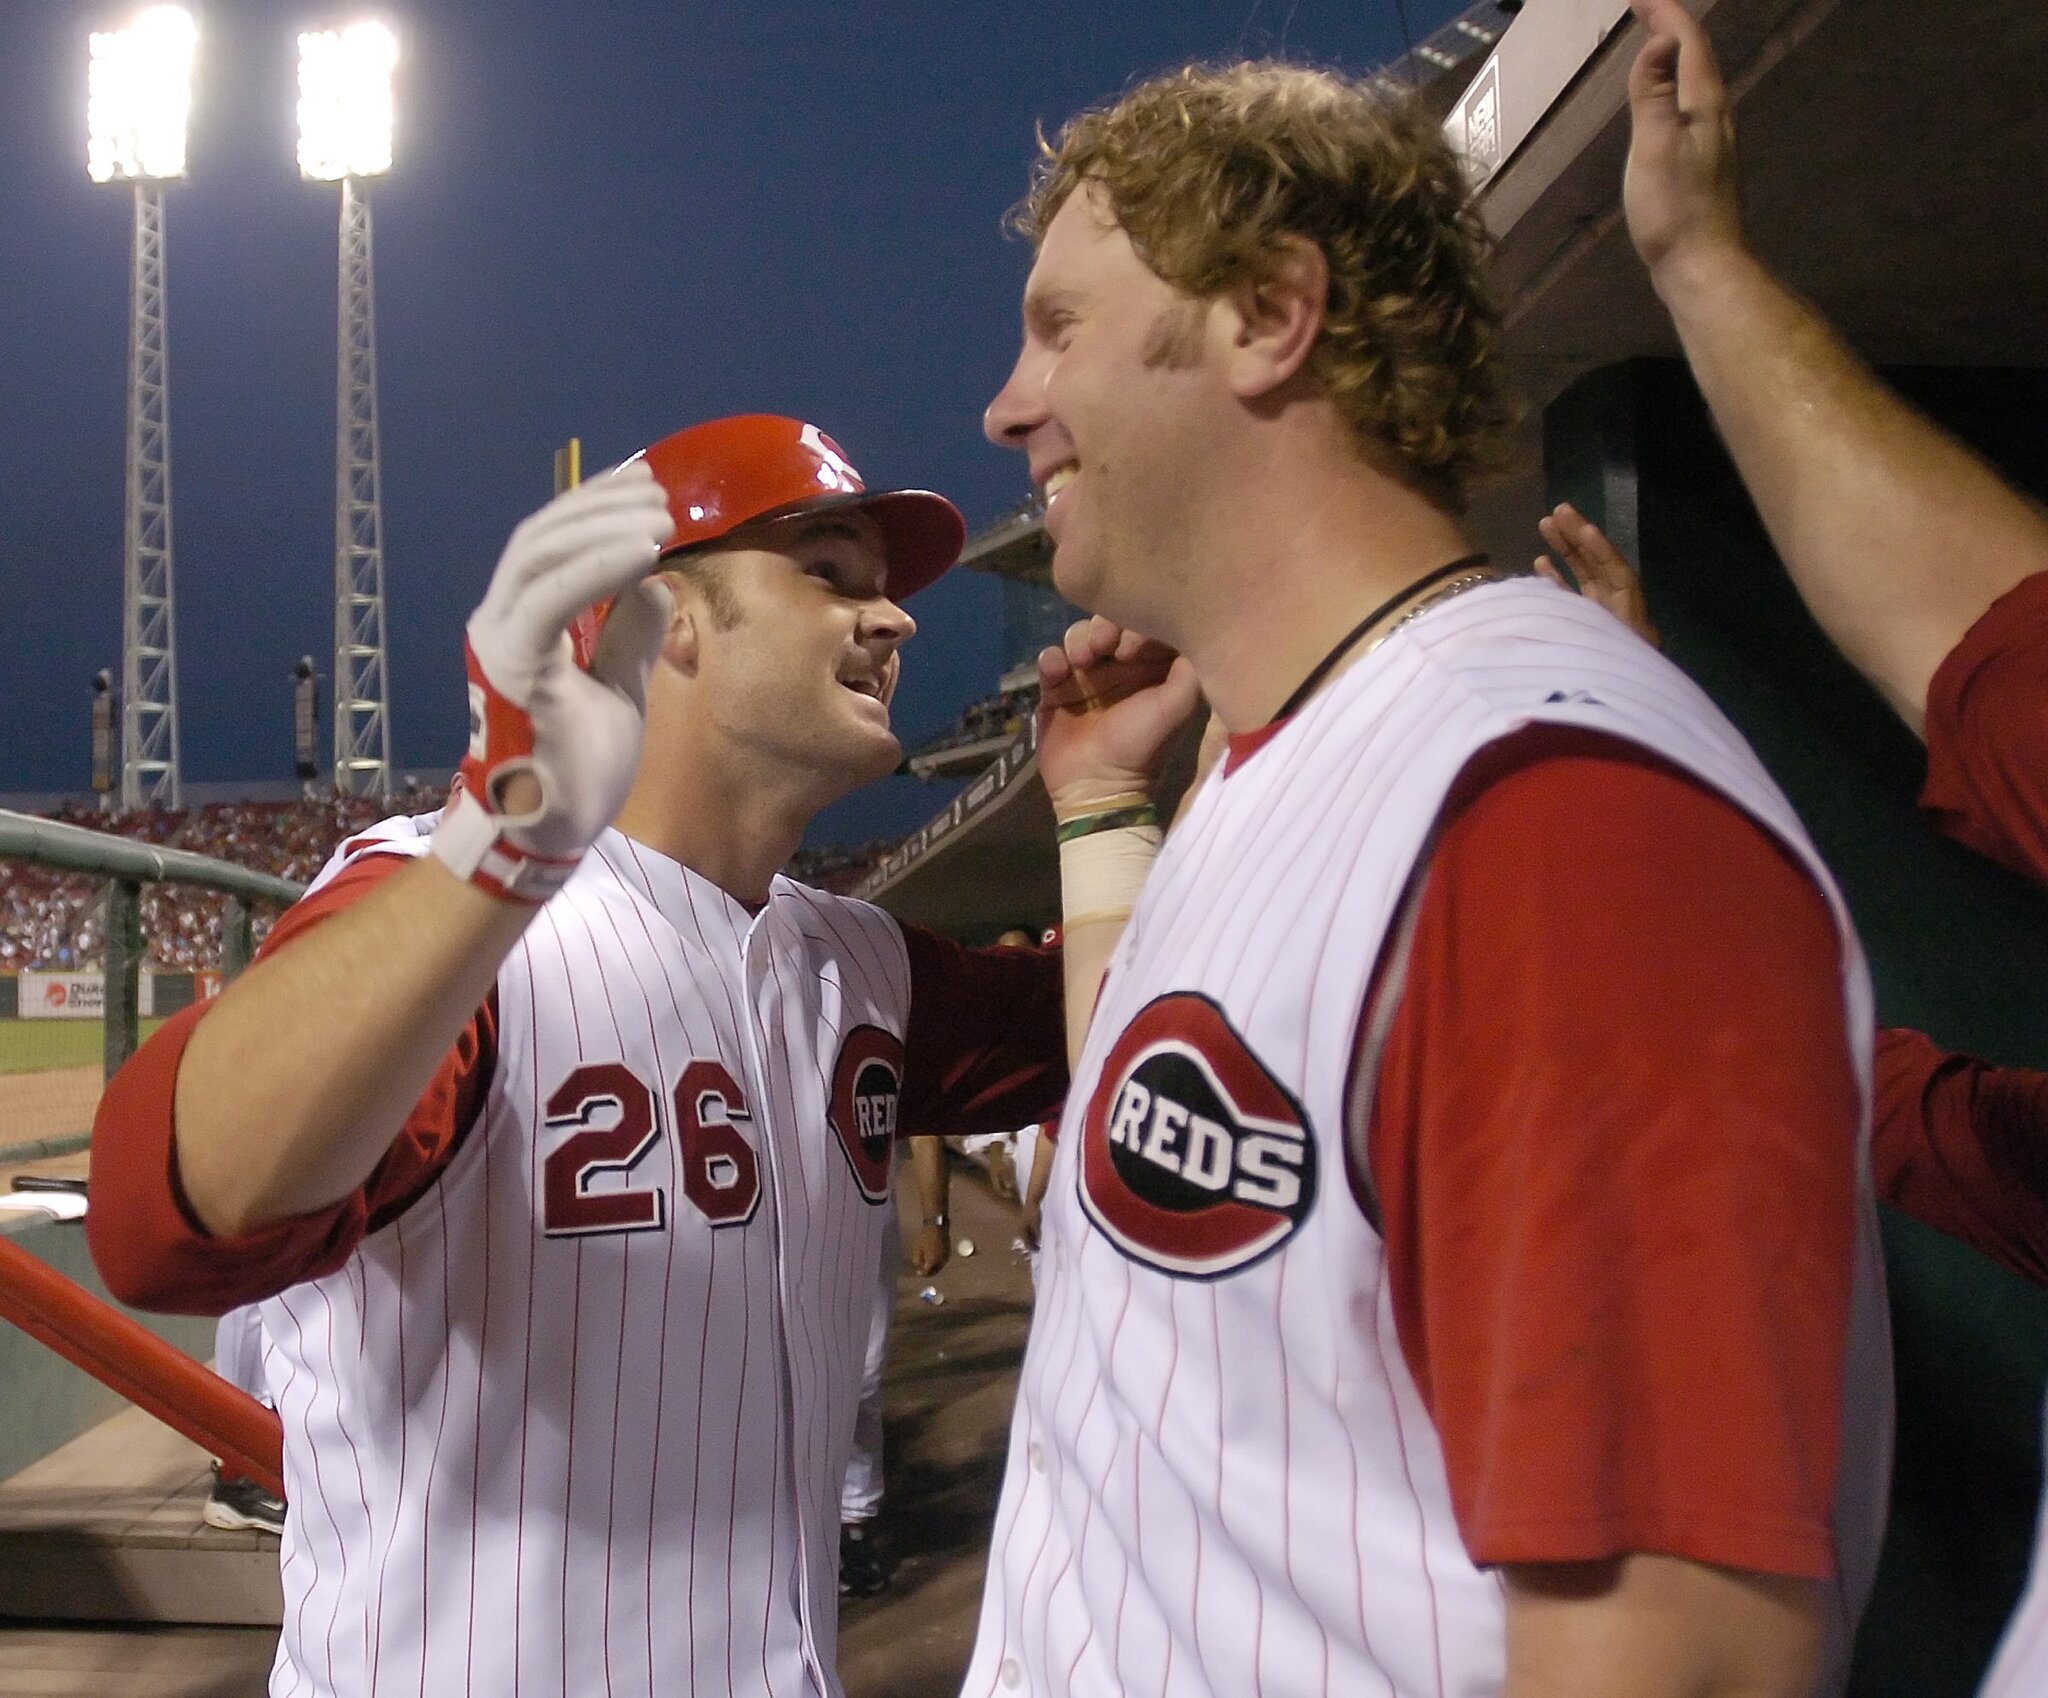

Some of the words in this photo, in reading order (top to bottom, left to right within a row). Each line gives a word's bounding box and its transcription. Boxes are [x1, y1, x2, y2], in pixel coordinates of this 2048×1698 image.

[544, 1058, 762, 1239] 26
[855, 1094, 898, 1139] RED
[1110, 1079, 1304, 1208] REDS
